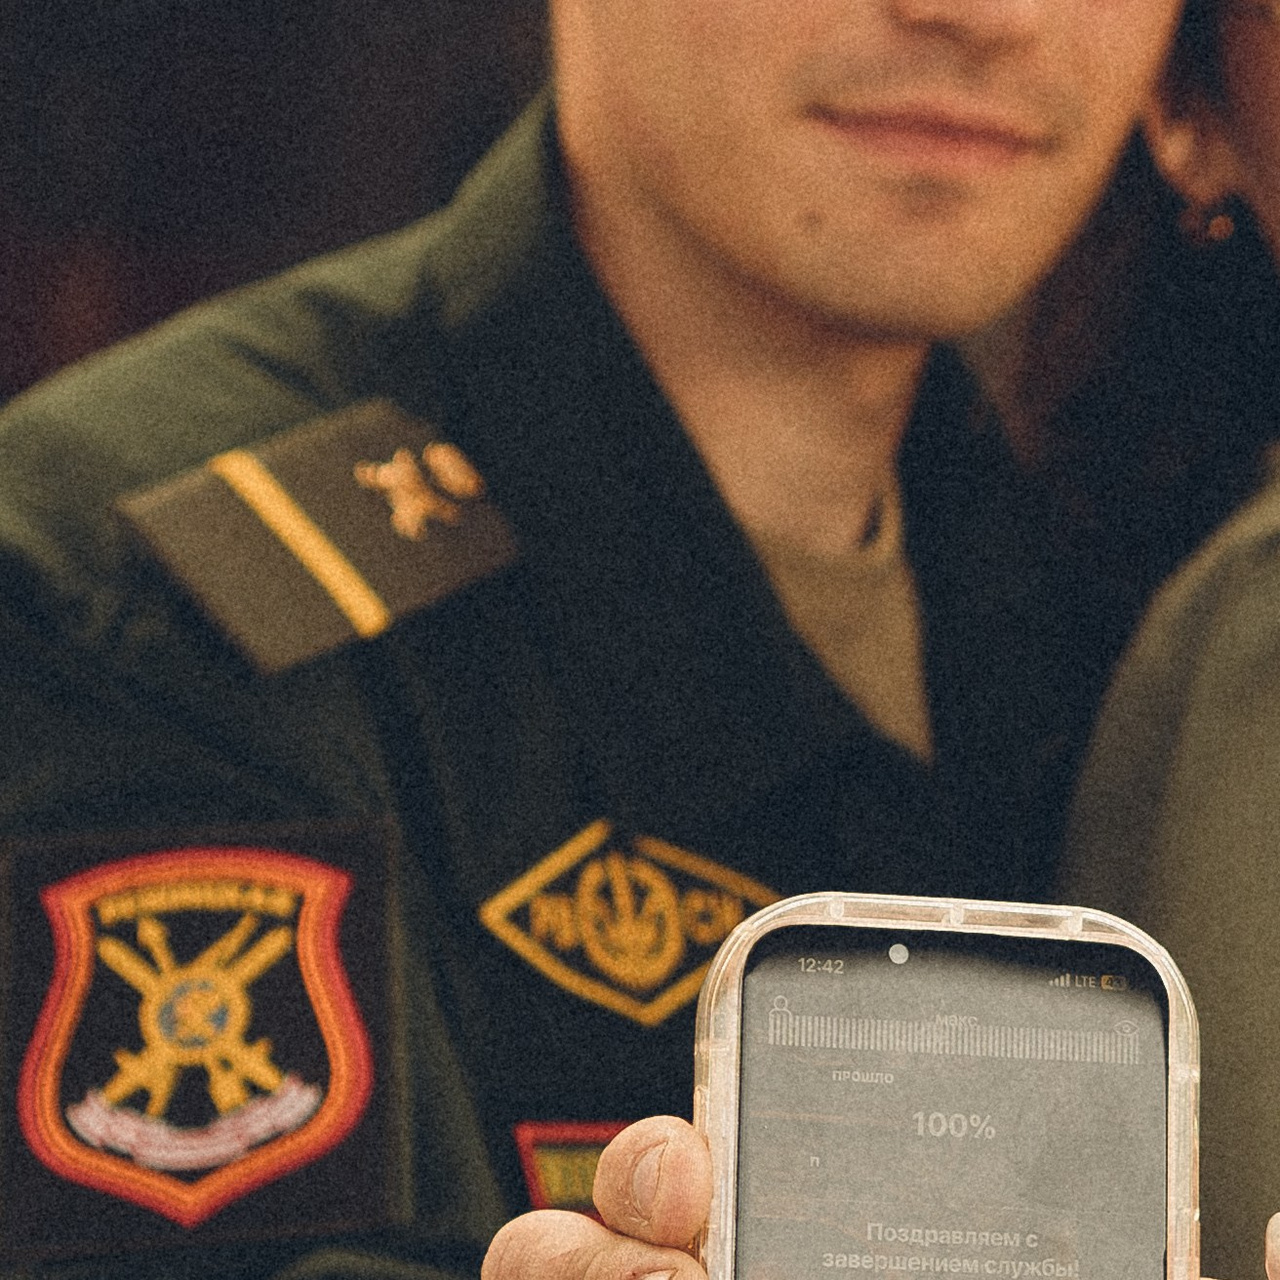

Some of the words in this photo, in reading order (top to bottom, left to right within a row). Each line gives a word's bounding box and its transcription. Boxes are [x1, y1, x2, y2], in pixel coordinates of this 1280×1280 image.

[798, 957, 844, 975] 12:42
[1075, 975, 1096, 988] LTE
[832, 1068, 894, 1085] прошло
[913, 1111, 996, 1140] 100%
[866, 1223, 1021, 1248] Поздравляем
[1026, 1231, 1038, 1248] с
[822, 1252, 978, 1275] завершением
[985, 1258, 1080, 1280] службы!
